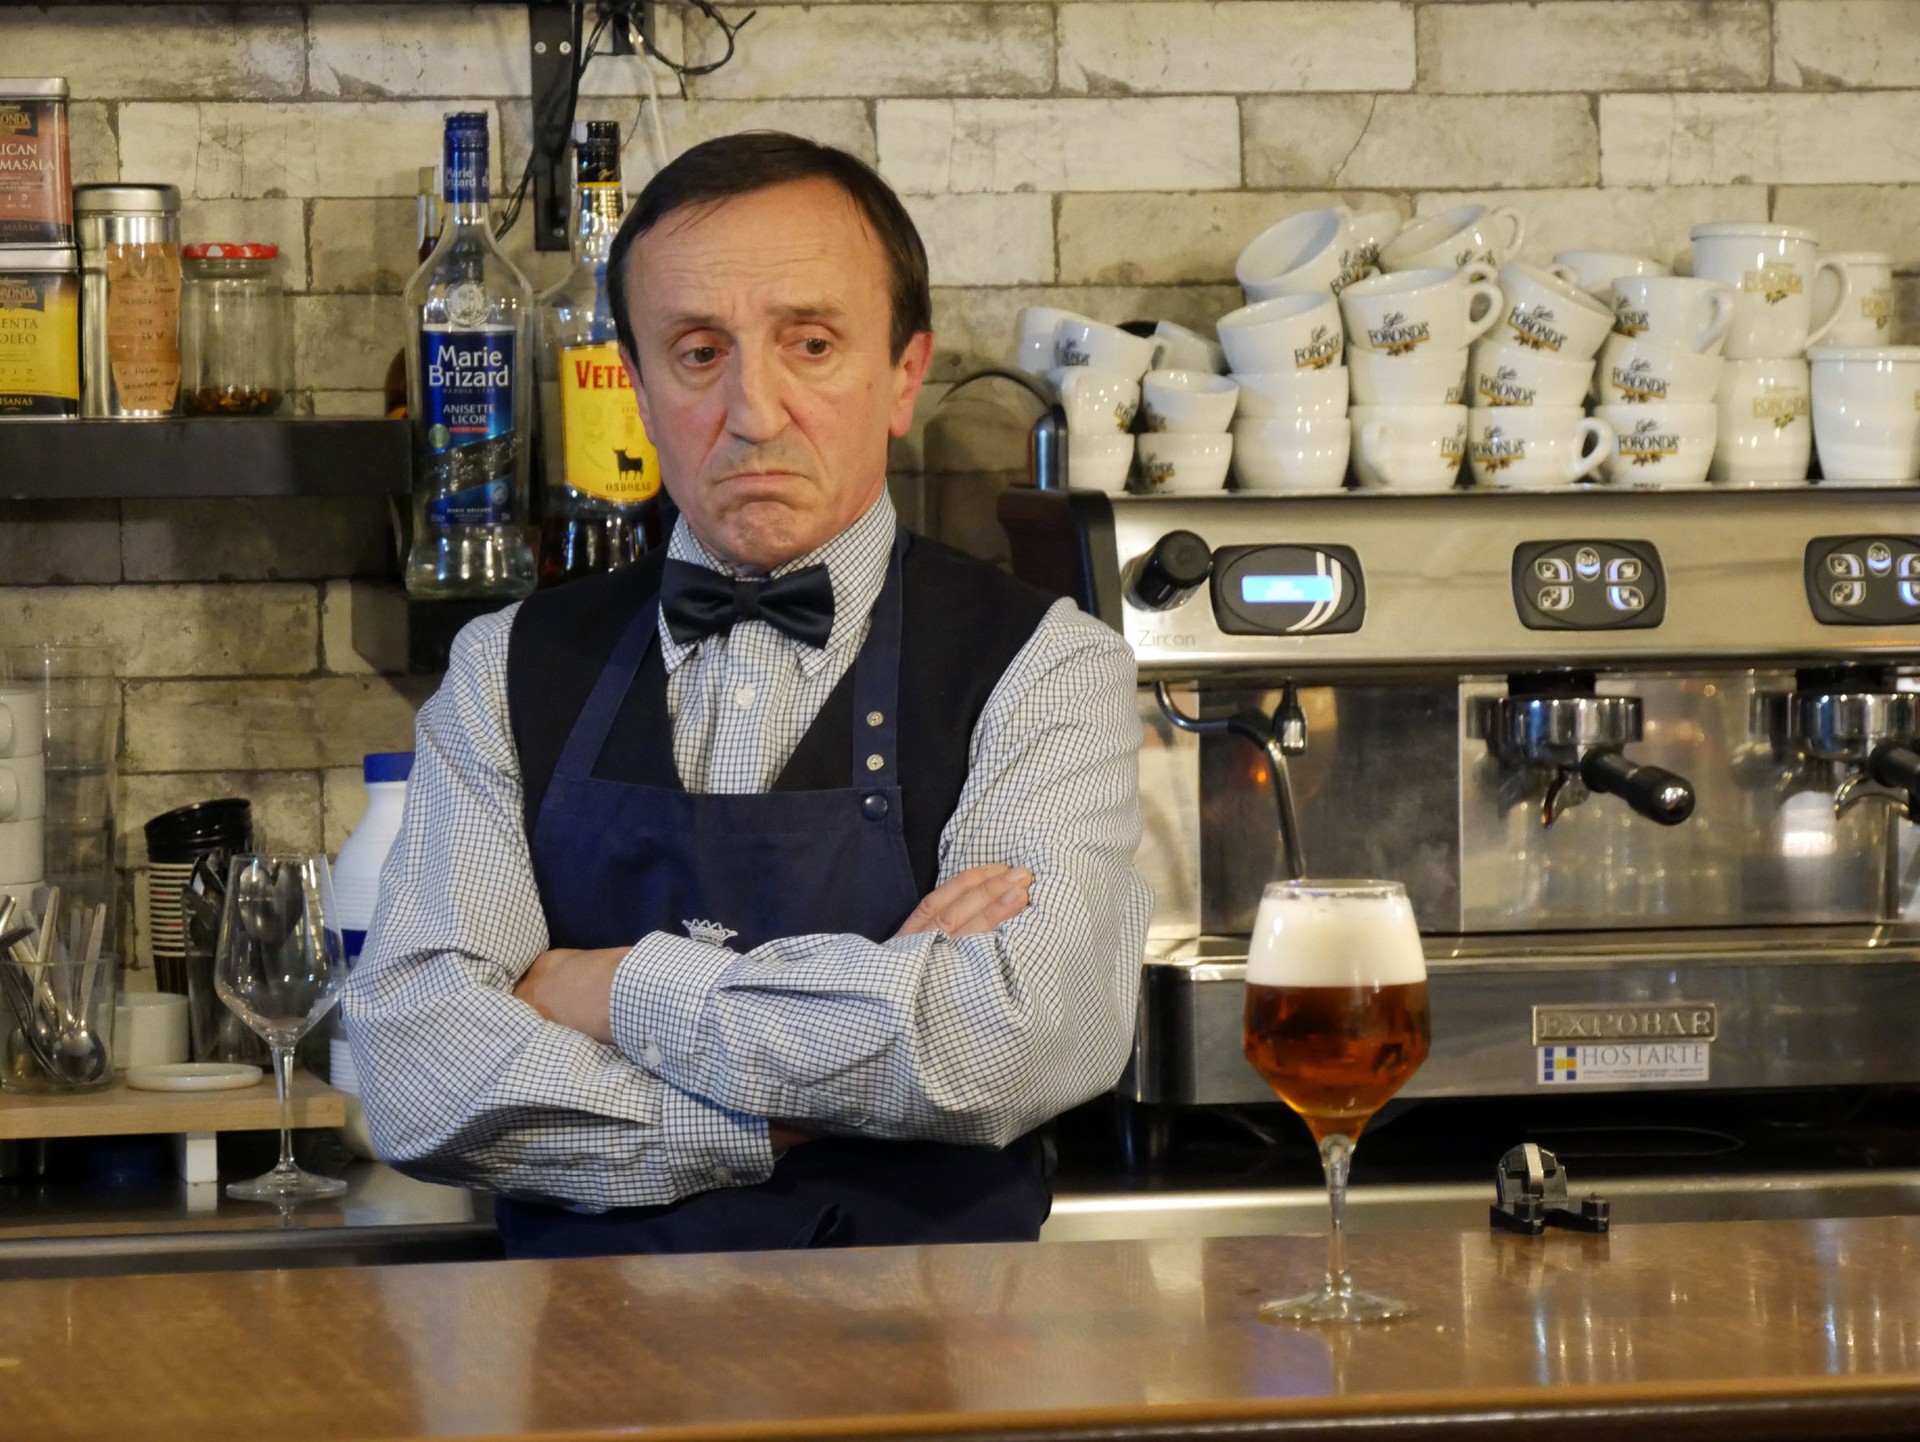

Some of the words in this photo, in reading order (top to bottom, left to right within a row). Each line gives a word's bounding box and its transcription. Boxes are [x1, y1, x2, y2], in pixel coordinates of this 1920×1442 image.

[0, 113, 31, 126] ONDA
[0, 143, 37, 155] ICAN
[1368, 321, 1431, 345] FORONDA
[437, 345, 502, 367] Marie
[428, 364, 509, 387] Brizard
[575, 360, 634, 389] VETE
[443, 404, 495, 414] ANISETTE
[451, 414, 487, 425] LICOR
[1618, 433, 1679, 455] FORONDA
[606, 481, 652, 492] OSBORNE
[1138, 630, 1196, 646] Zircon
[1541, 1010, 1712, 1037] EXPOBAR
[1582, 1045, 1704, 1066] HOSTARTE
